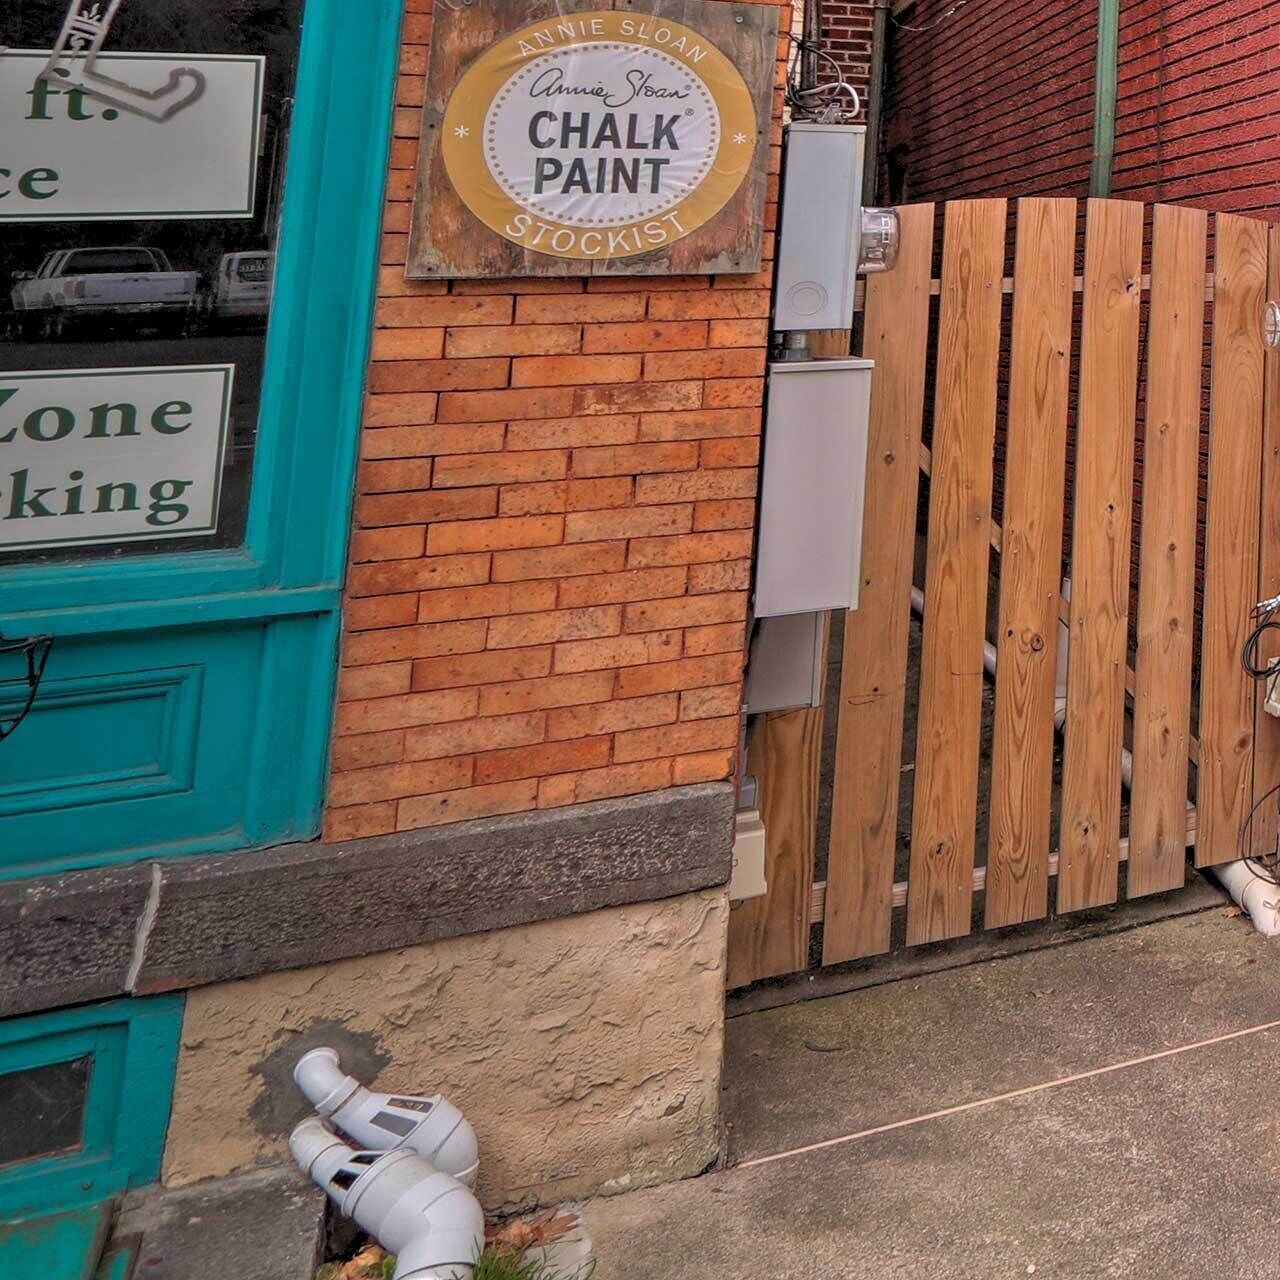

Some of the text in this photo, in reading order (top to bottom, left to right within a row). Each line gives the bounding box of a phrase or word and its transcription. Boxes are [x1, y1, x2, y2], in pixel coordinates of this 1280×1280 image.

[517, 19, 708, 64] ANNIE SLOAN
[25, 67, 119, 121] ft.
[529, 67, 690, 108] Annie Sloan
[528, 110, 682, 151] CHALK
[533, 157, 671, 195] PAINT
[505, 210, 685, 255] STOCKIST
[0, 468, 194, 527] king
